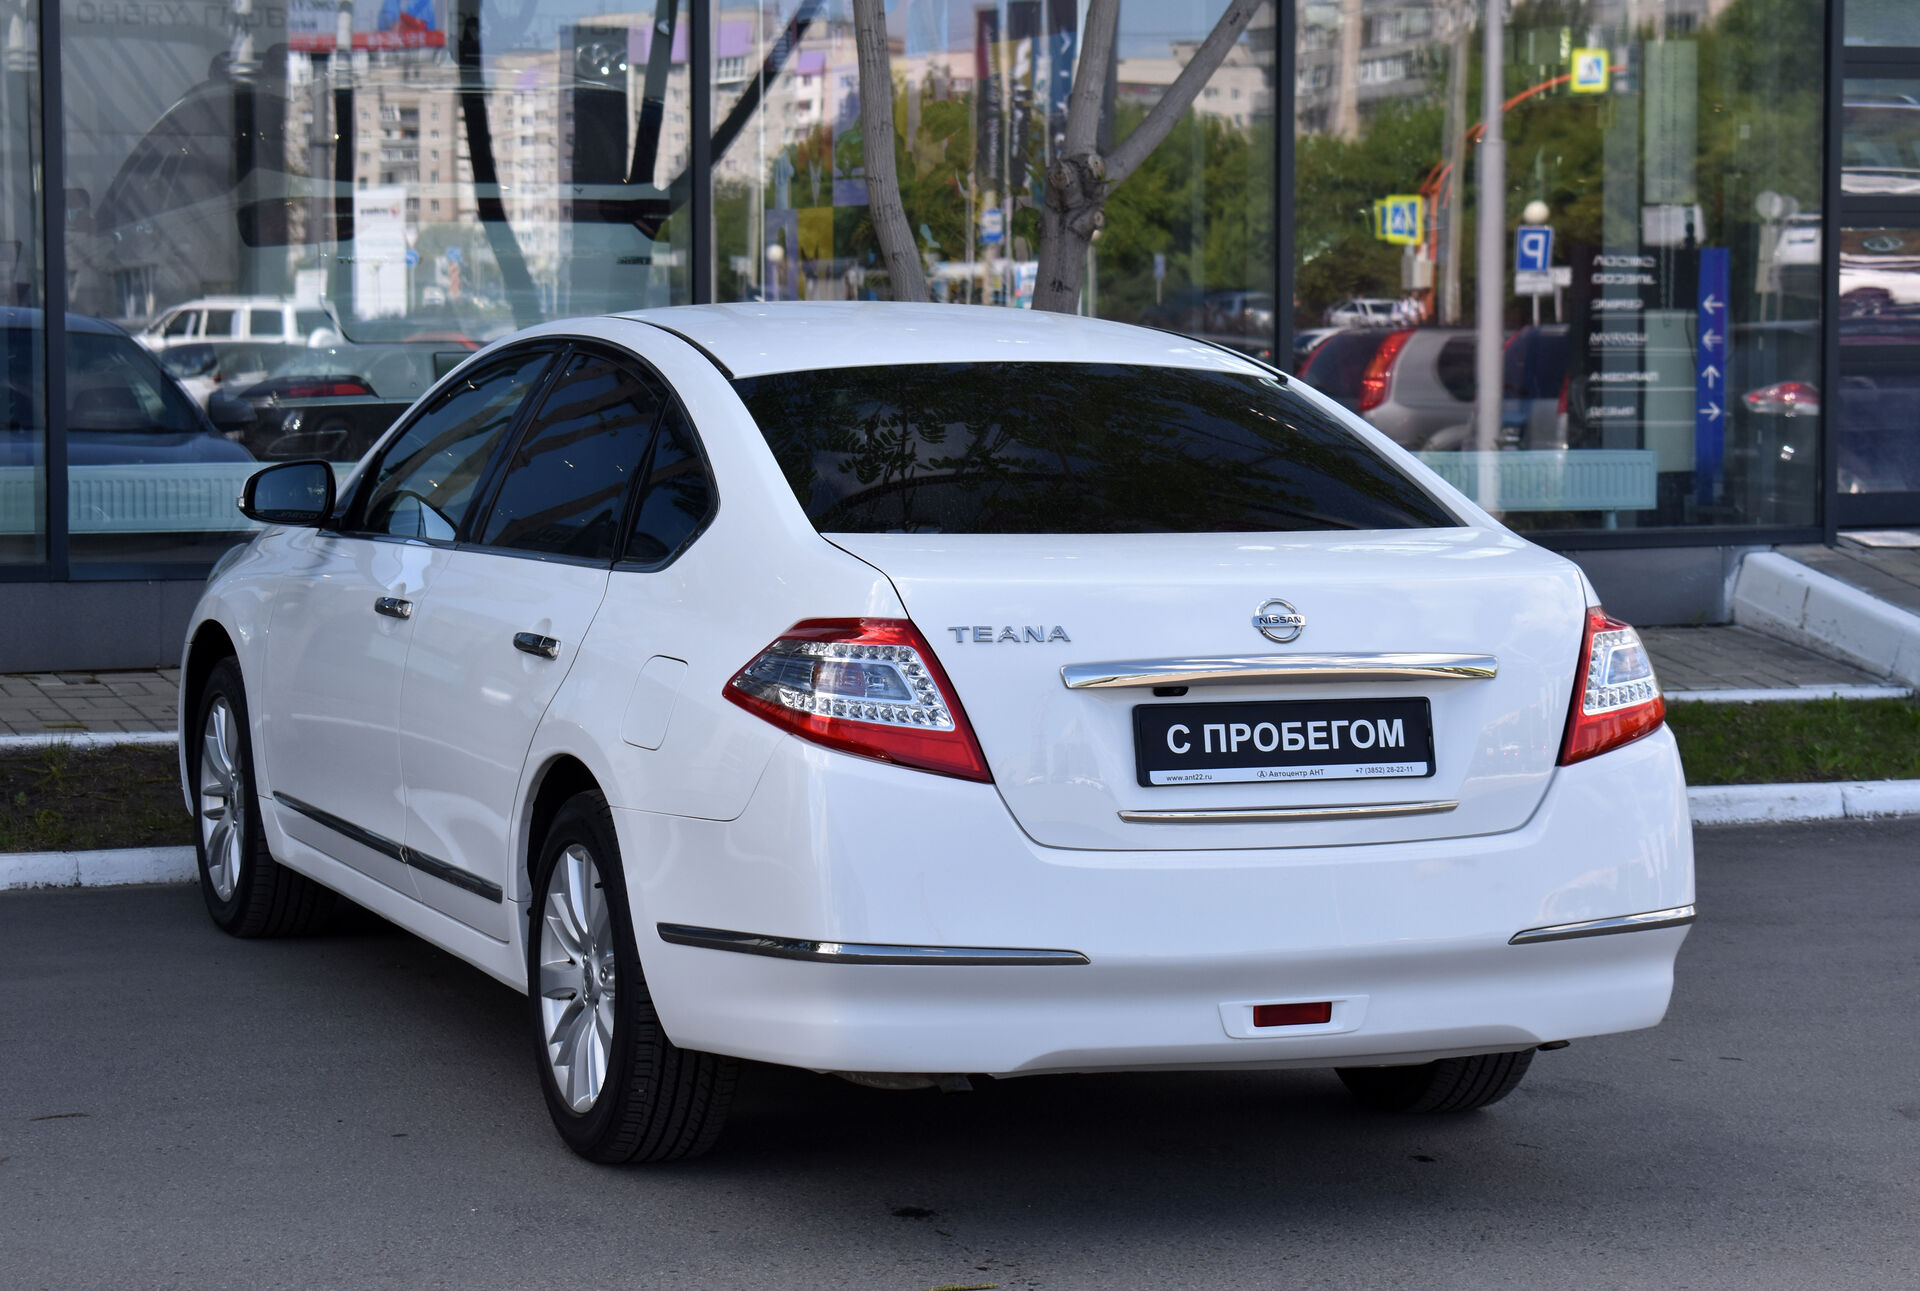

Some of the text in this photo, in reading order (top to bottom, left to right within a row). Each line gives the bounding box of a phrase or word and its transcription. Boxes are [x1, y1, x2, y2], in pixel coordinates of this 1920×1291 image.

[1258, 615, 1303, 626] NISSAN
[948, 625, 1071, 643] TEANA
[1166, 718, 1405, 754] С ПРОБЕГОМ
[1269, 770, 1308, 779] Автоцентр
[1309, 769, 1325, 777] АНТ
[1364, 766, 1386, 776] (3852)
[1387, 766, 1413, 774] 28-22-11
[1166, 774, 1213, 782] www.ant22.ru
